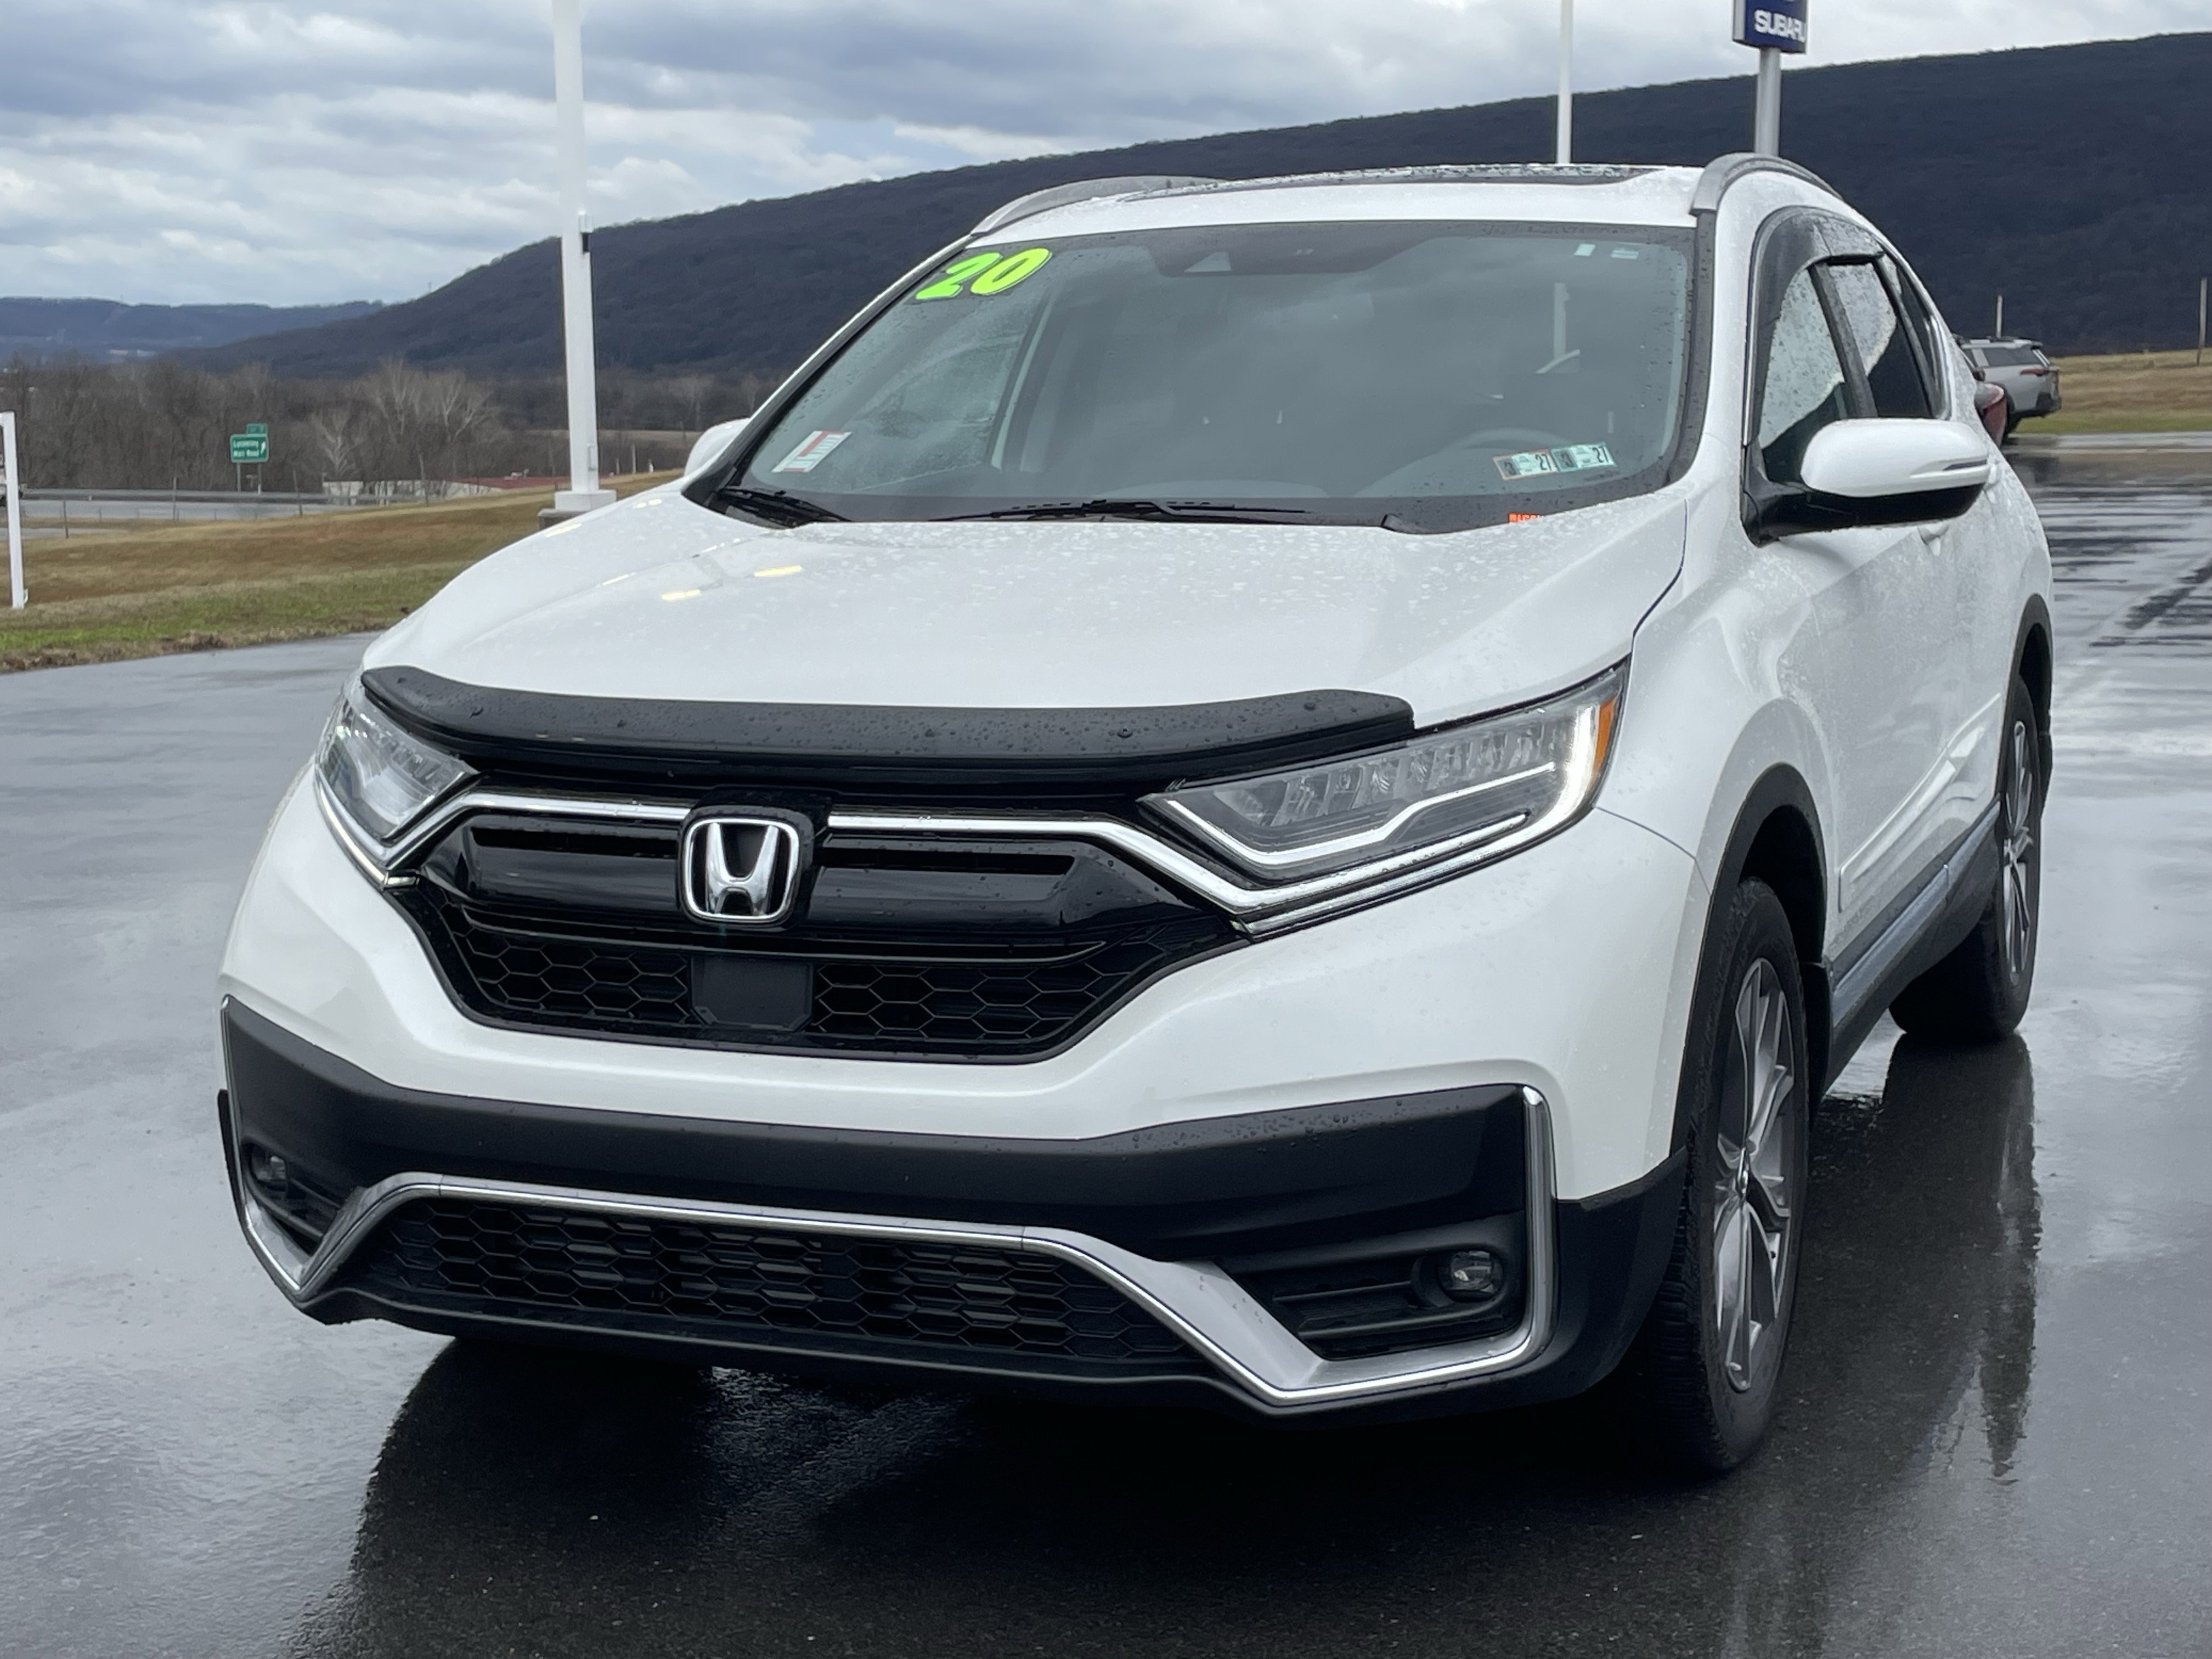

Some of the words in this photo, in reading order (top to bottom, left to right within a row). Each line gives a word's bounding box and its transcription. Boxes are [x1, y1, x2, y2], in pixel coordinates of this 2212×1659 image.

[915, 247, 1052, 300] 20
[1535, 454, 1552, 471] 27
[1592, 445, 1609, 463] 27
